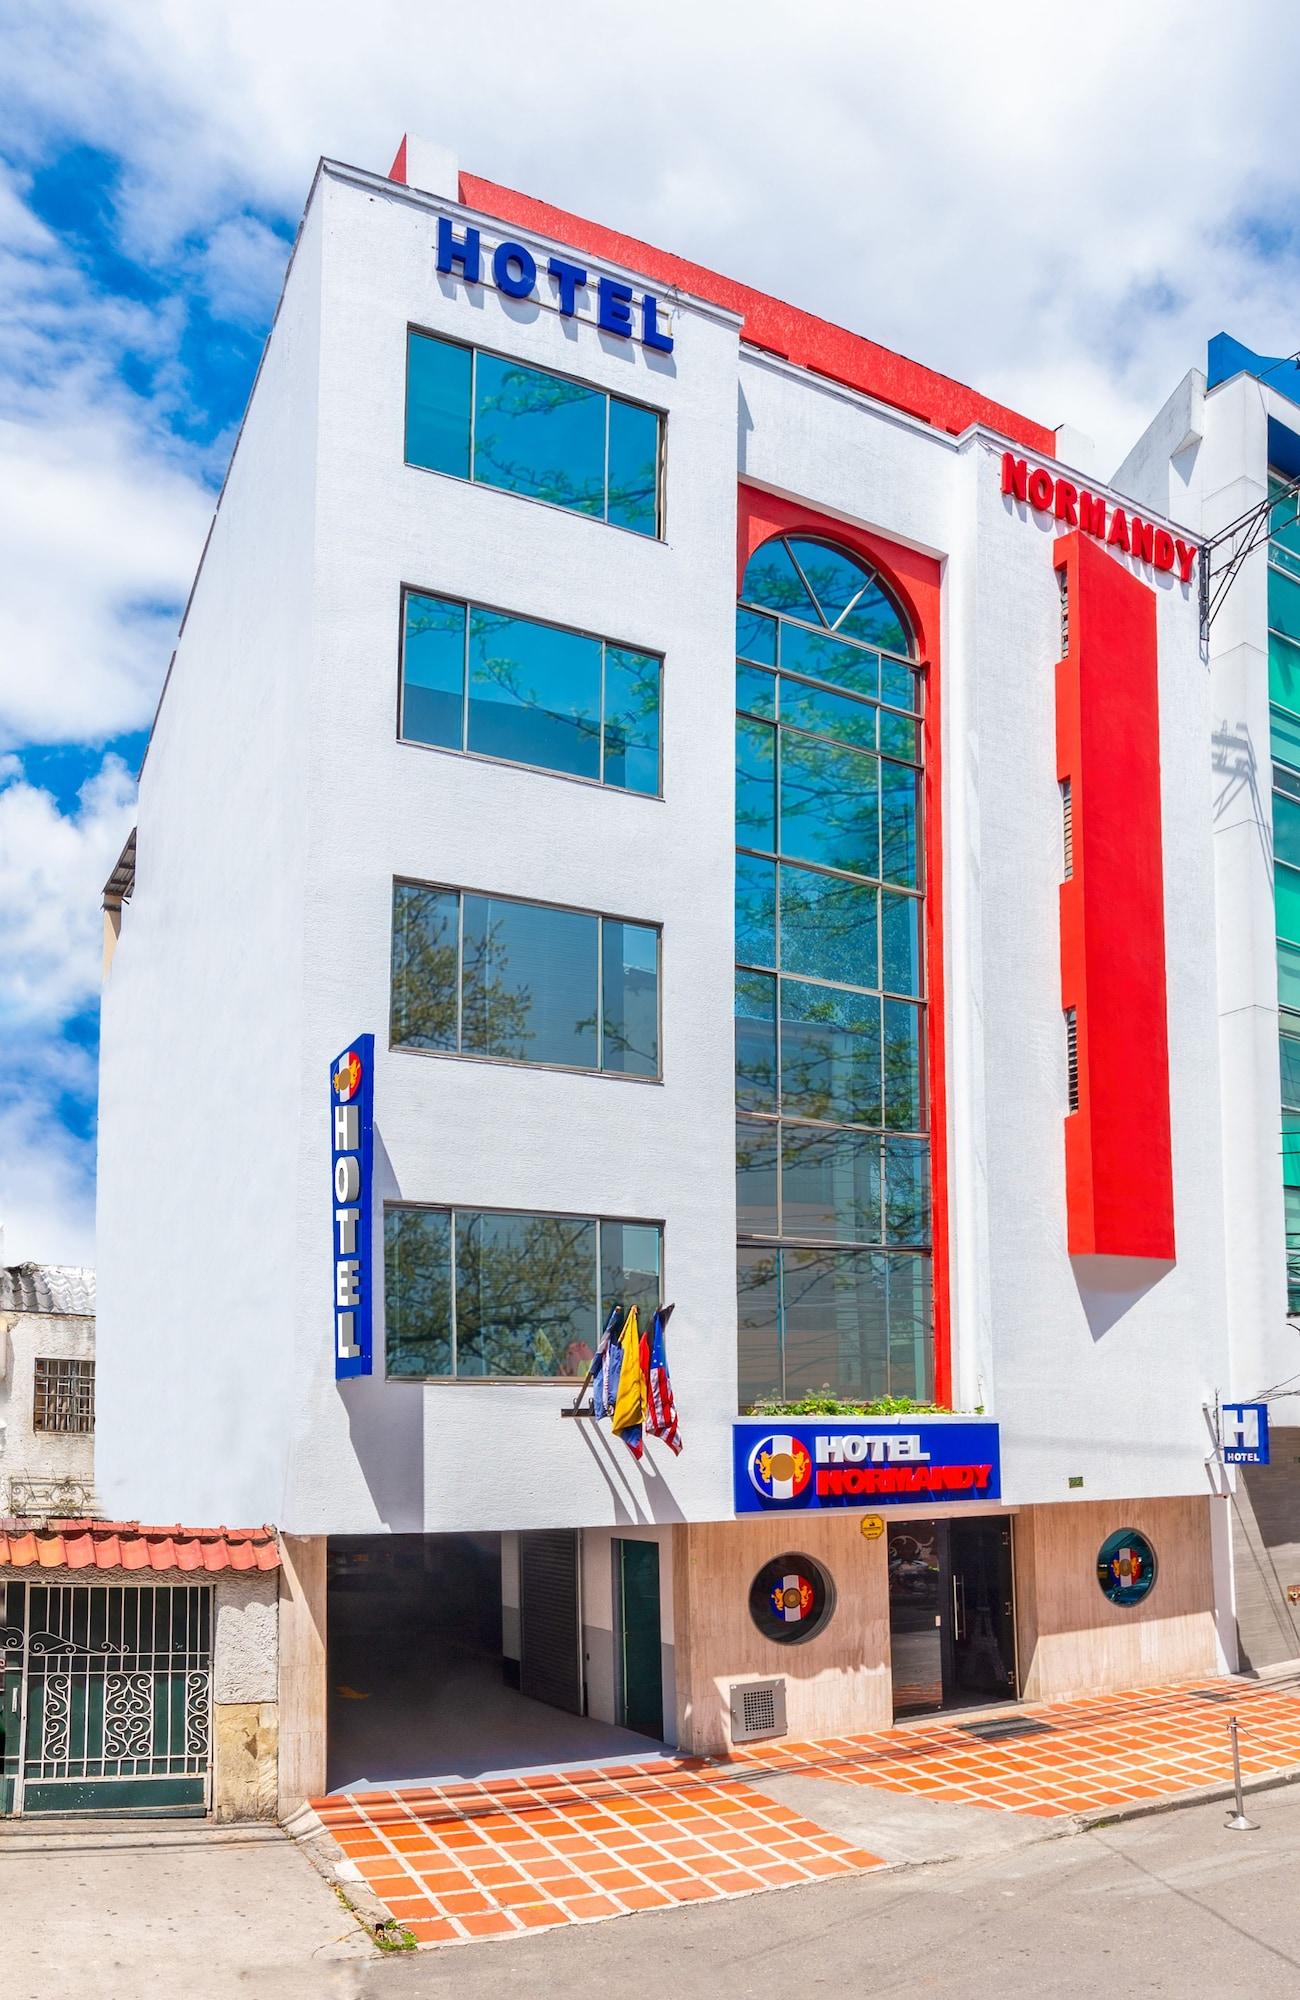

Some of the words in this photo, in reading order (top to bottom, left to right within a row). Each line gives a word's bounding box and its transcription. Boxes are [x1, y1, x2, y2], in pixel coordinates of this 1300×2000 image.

[435, 217, 674, 354] HOTEL
[1000, 452, 1198, 583] NORMANDY
[335, 1105, 360, 1359] HOTEL
[1223, 1409, 1259, 1447] H
[815, 1435, 930, 1464] HOTEL
[1227, 1452, 1260, 1462] HOTEL
[816, 1464, 992, 1496] NORMANDY
